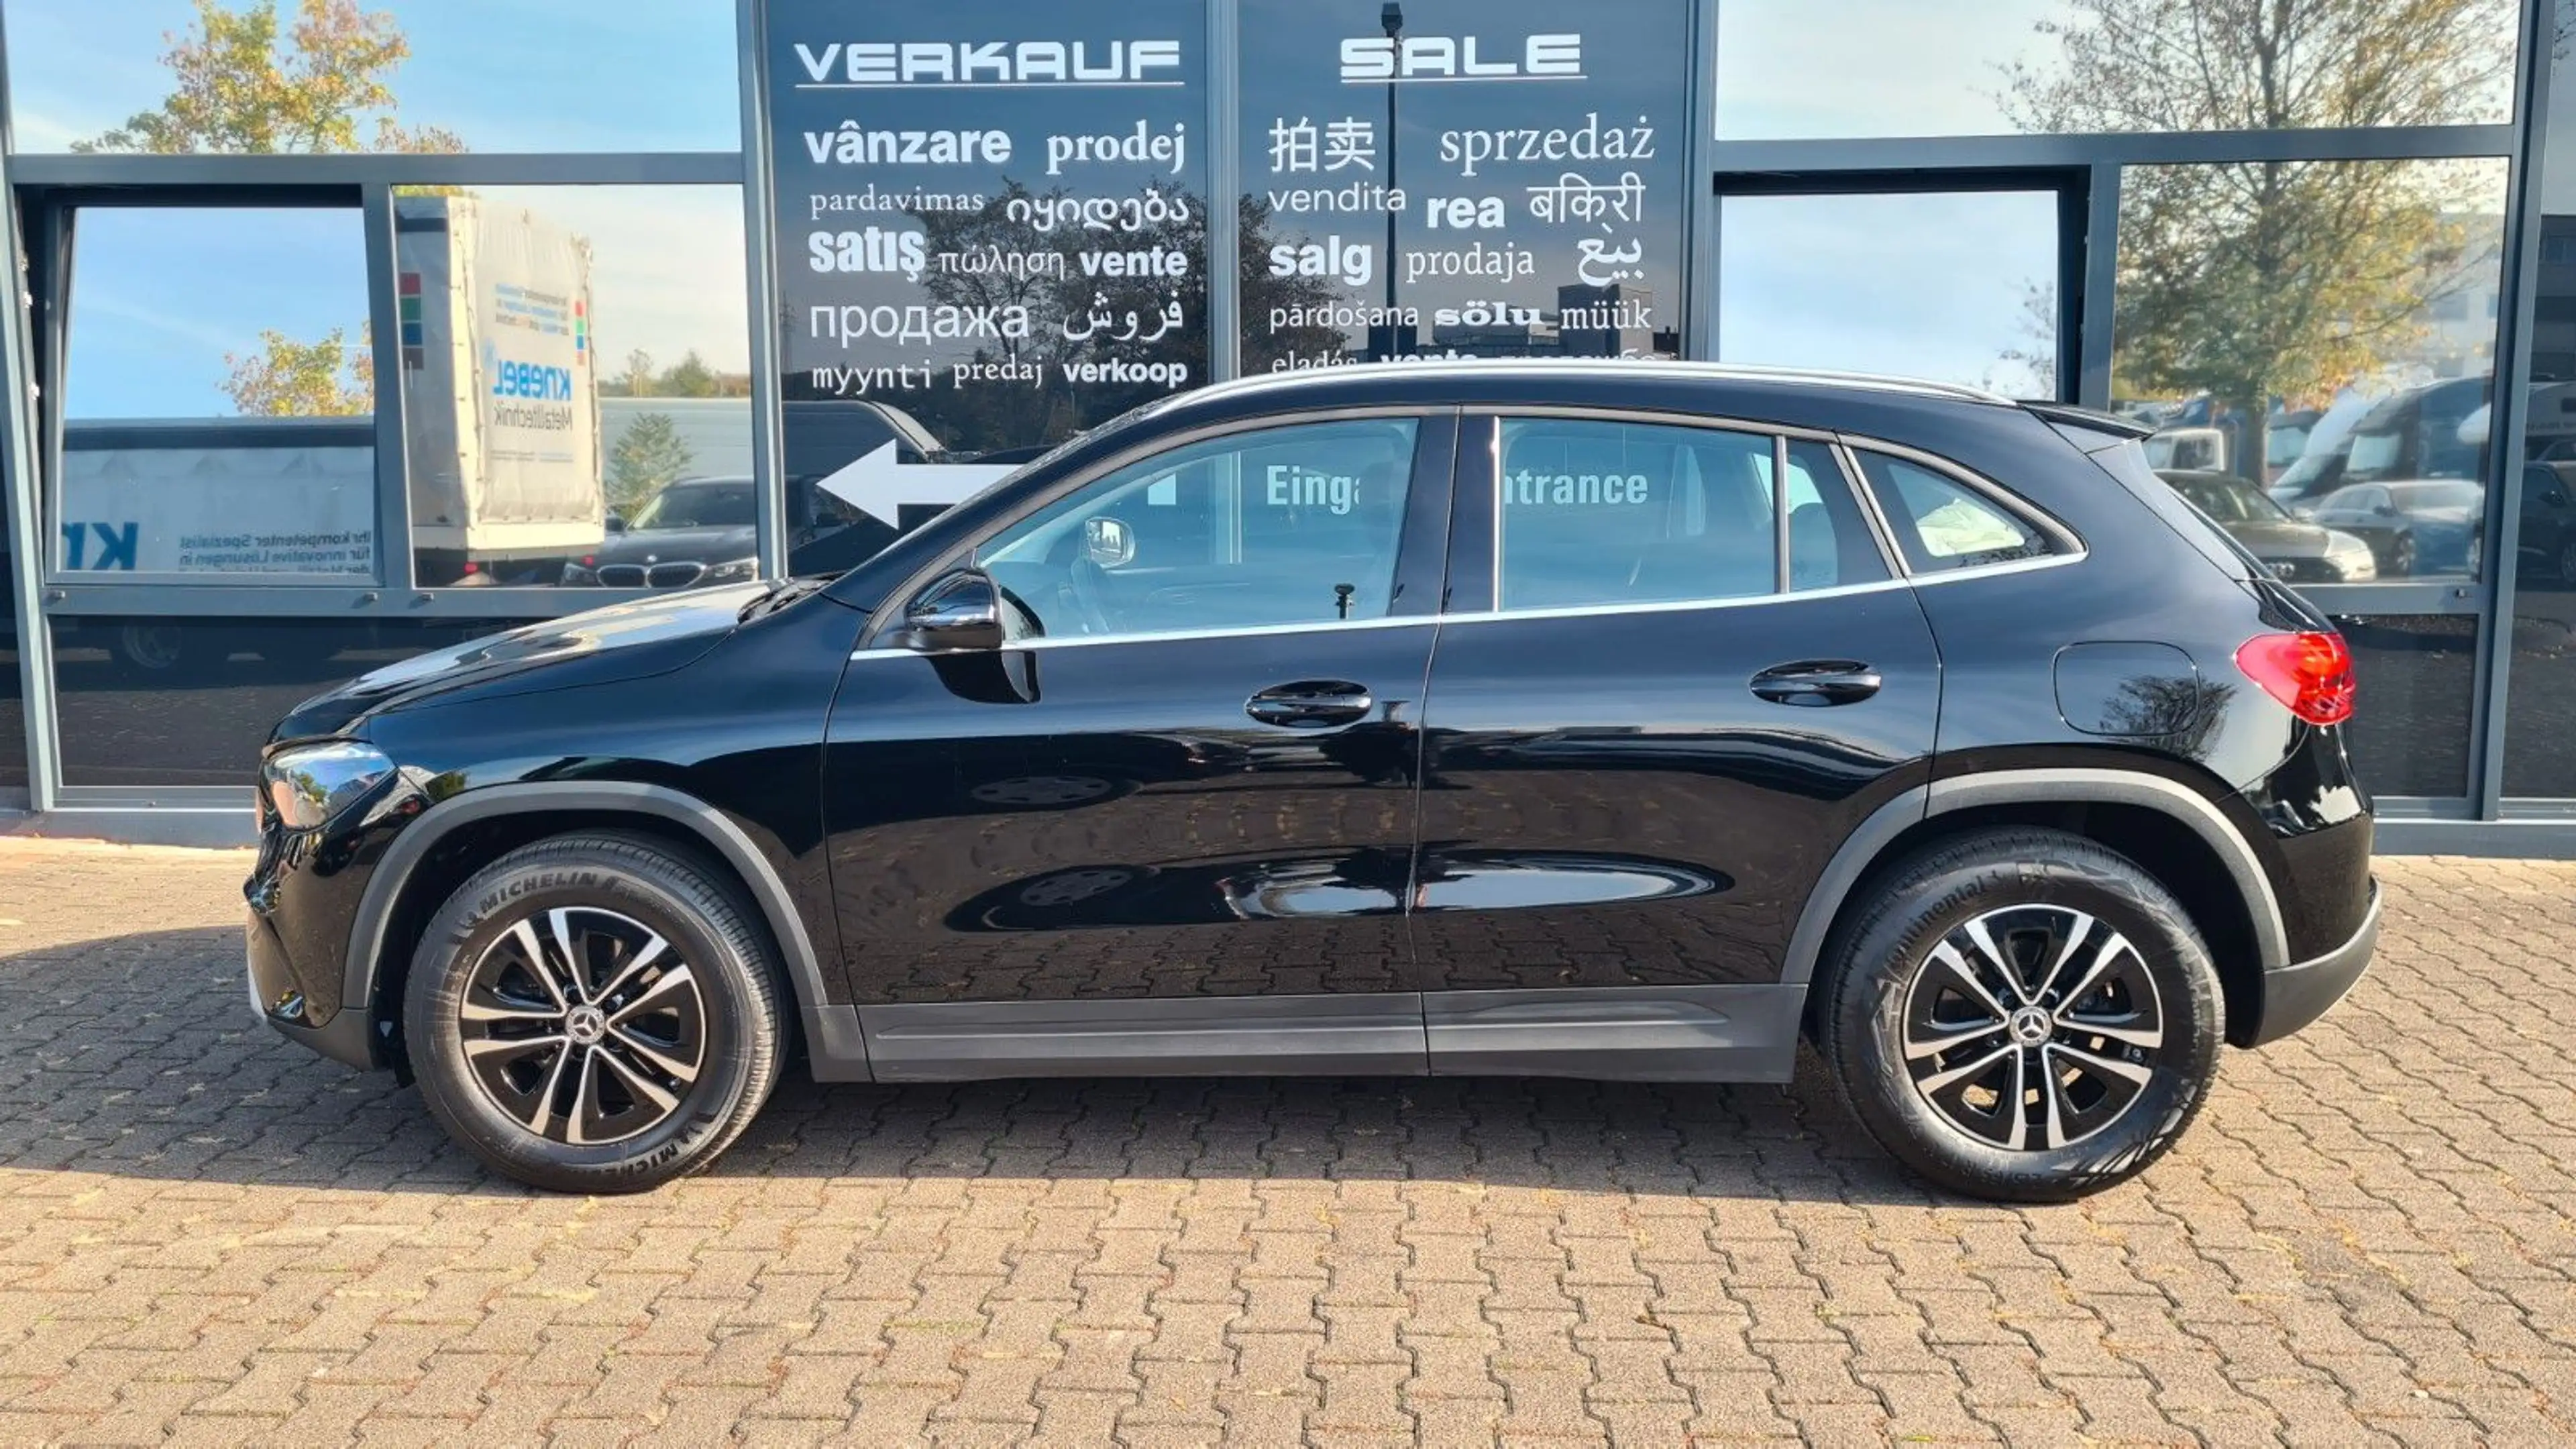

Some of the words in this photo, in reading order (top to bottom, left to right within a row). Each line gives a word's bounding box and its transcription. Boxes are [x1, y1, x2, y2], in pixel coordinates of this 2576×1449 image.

[794, 41, 1179, 81] VERKAUF
[1341, 34, 1580, 76] SALE
[804, 119, 1011, 164] vânzare
[1046, 120, 1185, 174] prodej
[1269, 116, 1375, 172] 拍卖
[1440, 113, 1655, 176] sprzedaż
[810, 183, 984, 220] pardavimas
[1007, 188, 1189, 231] იყიდება
[1268, 182, 1405, 212] vendita
[1427, 196, 1505, 229] rea
[808, 226, 924, 282] satış
[938, 244, 1065, 281] πώληση
[1079, 246, 1187, 276] vente
[1269, 235, 1372, 285] salg
[1406, 242, 1534, 282] prodaja
[810, 305, 1029, 347] продажа
[1269, 301, 1418, 334] pārdošana
[1560, 299, 1651, 329] müük
[812, 359, 932, 394] myynti
[953, 354, 1043, 388] predaj
[1063, 359, 1187, 387] verkoop
[479, 873, 598, 914] MICHELIN
